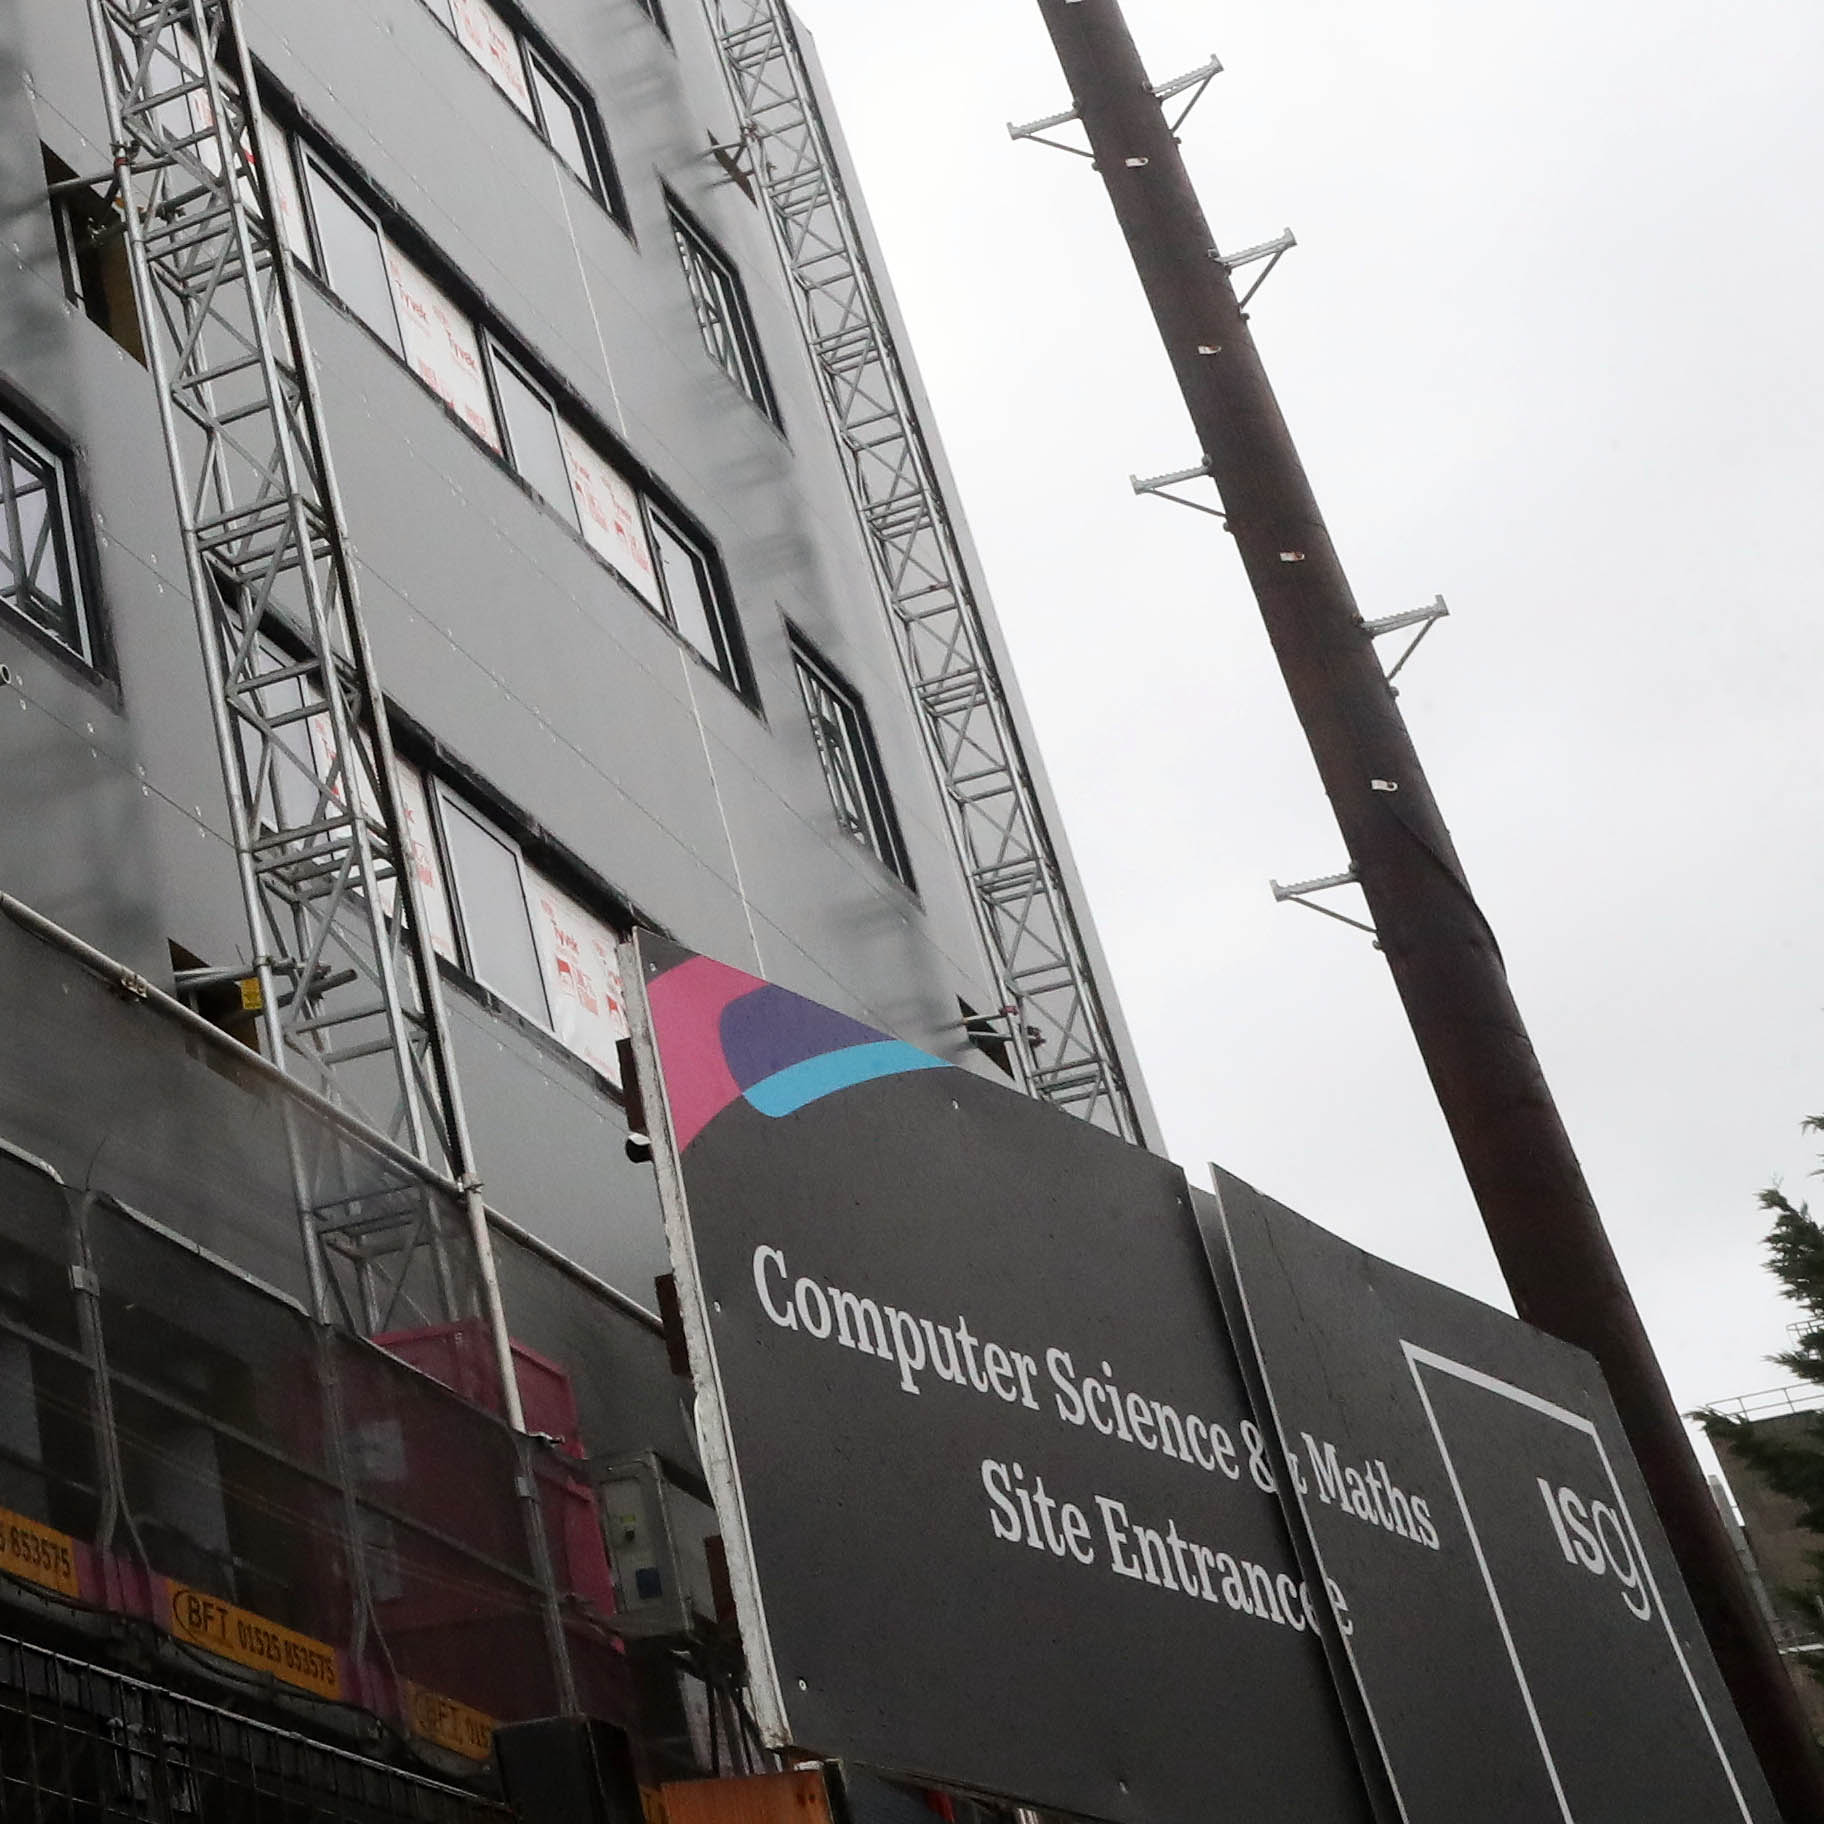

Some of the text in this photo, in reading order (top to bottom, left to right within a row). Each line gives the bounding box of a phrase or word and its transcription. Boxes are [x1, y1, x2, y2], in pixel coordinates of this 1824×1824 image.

[752, 1244, 1441, 1551] Computer Science & Maths
[188, 1594, 229, 1640] BFT
[980, 1458, 1354, 1637] Site Entrance
